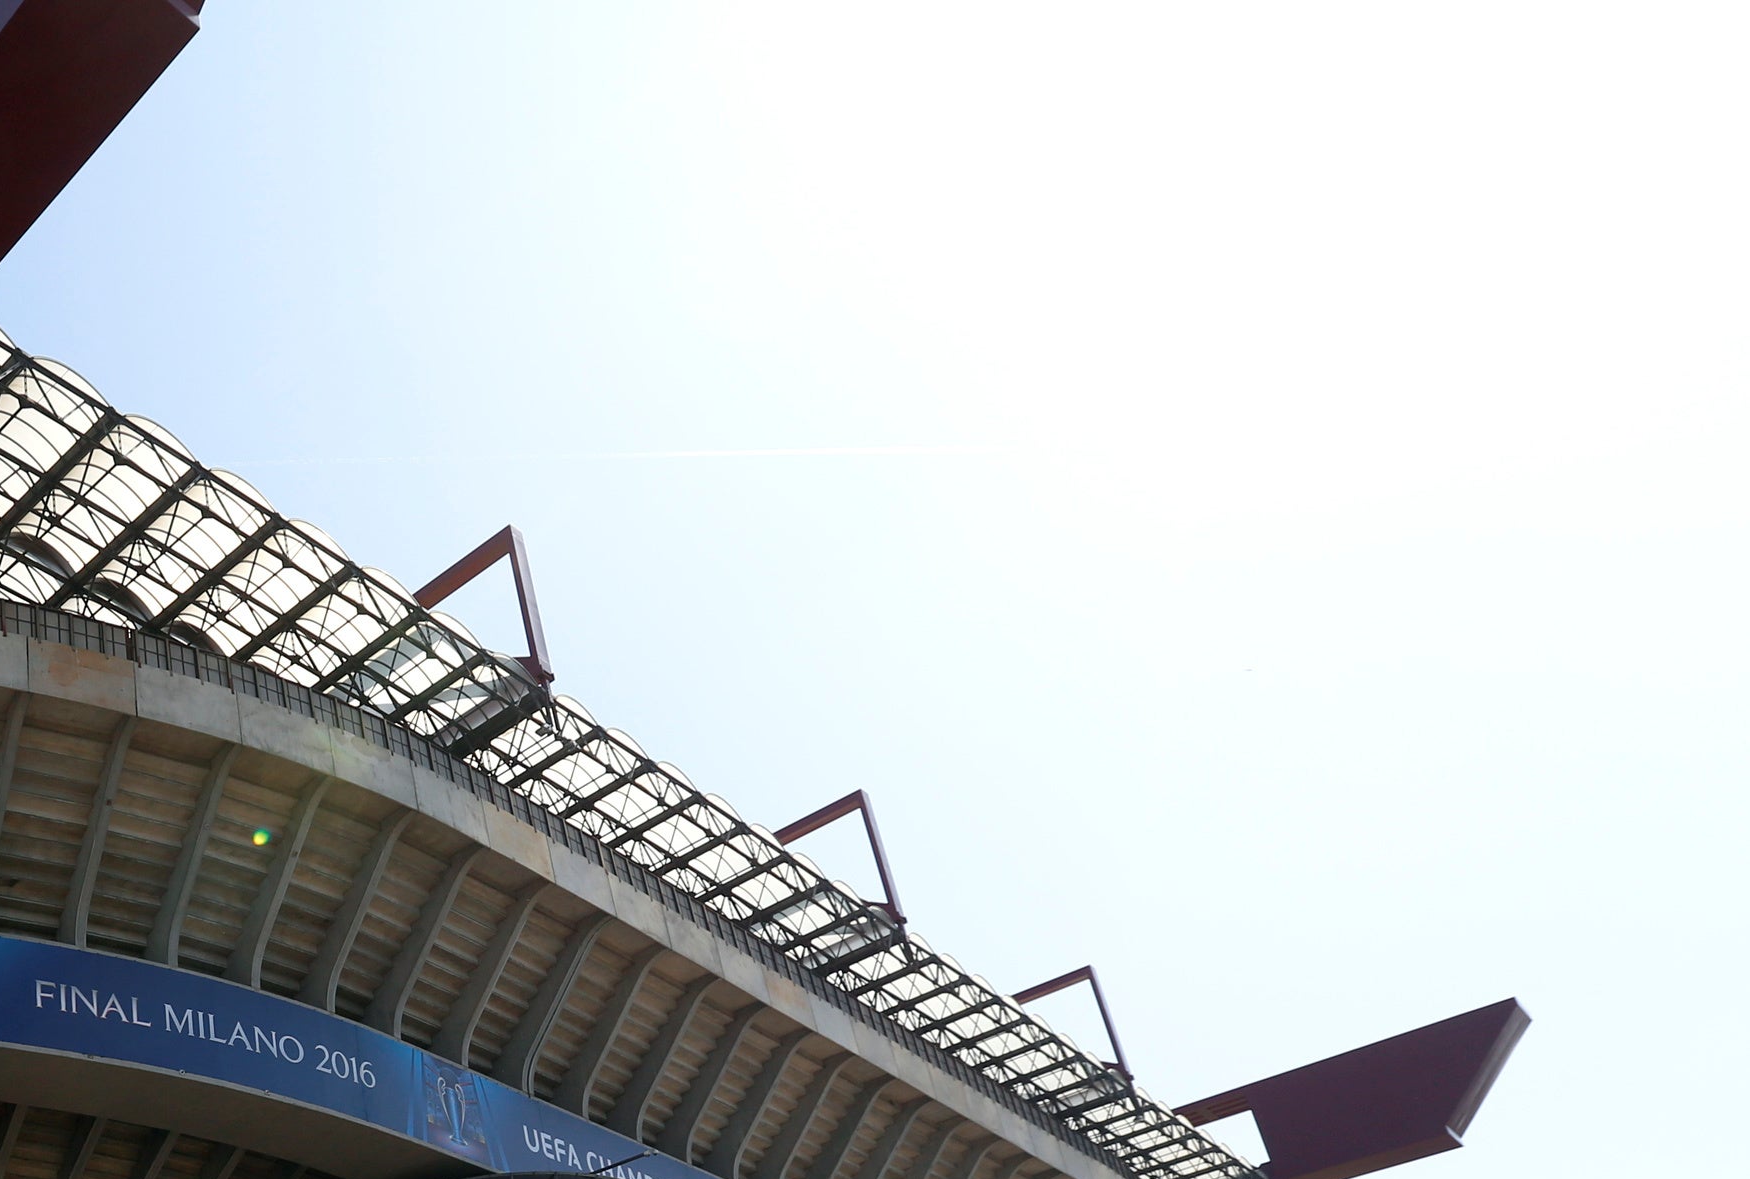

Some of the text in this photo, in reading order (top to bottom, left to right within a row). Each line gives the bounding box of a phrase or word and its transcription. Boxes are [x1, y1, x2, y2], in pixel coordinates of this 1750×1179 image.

[35, 979, 376, 1088] FINAL MILANO 2016
[522, 1124, 583, 1171] UEFA
